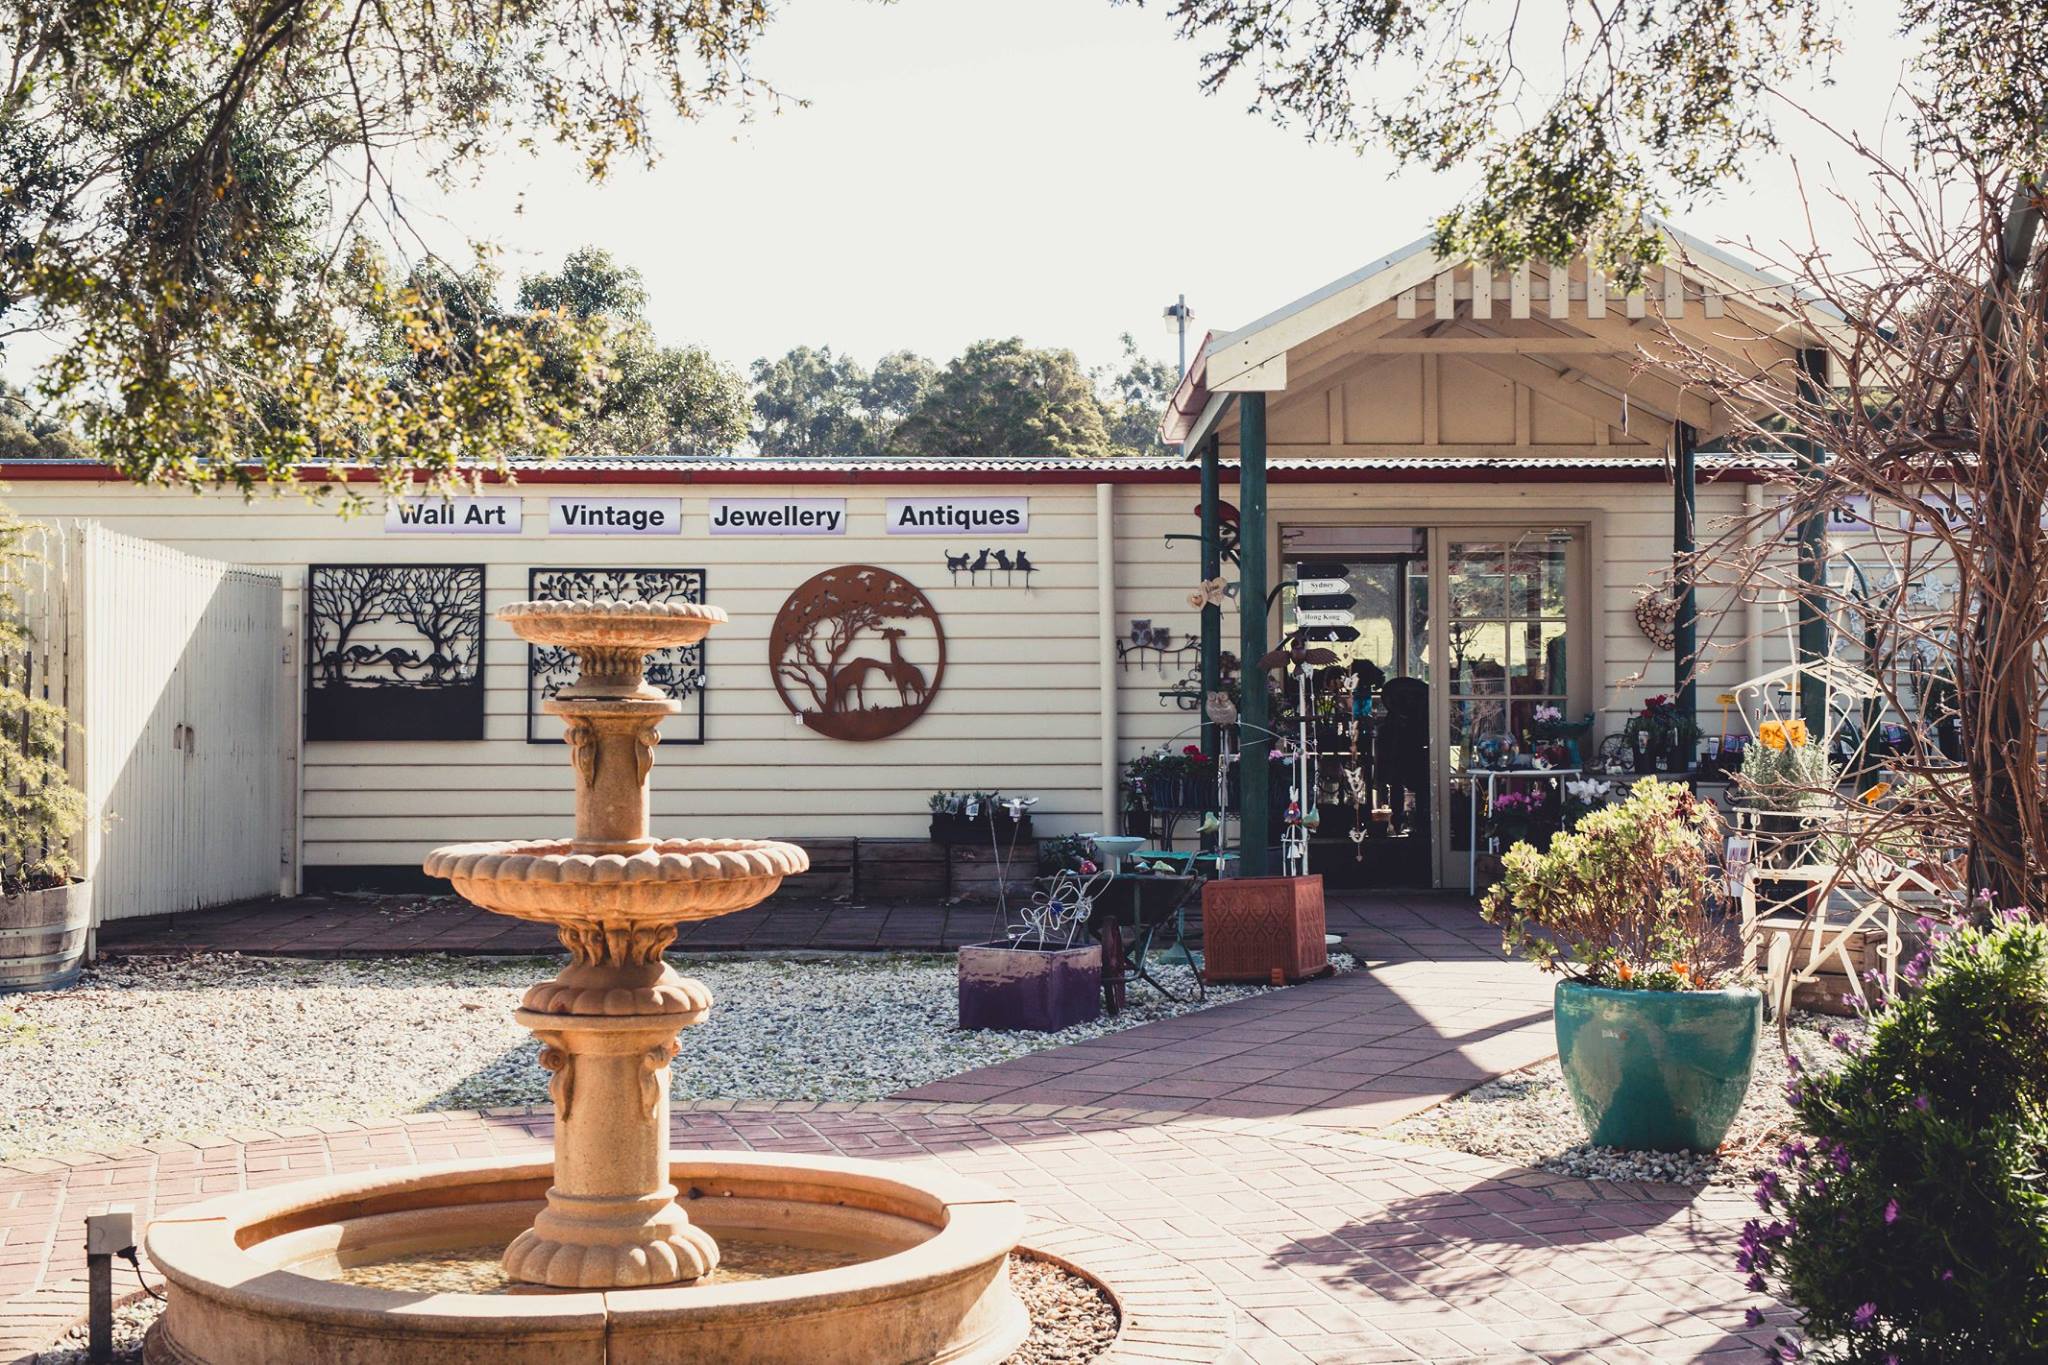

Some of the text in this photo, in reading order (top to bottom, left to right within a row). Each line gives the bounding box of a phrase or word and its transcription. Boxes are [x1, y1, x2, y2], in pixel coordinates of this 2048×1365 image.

[397, 503, 506, 525] Wall Art
[560, 504, 665, 531] Vintage
[714, 505, 841, 531] Jewellery
[898, 505, 1020, 530] Antiques
[1304, 613, 1341, 621] Hong Kong
